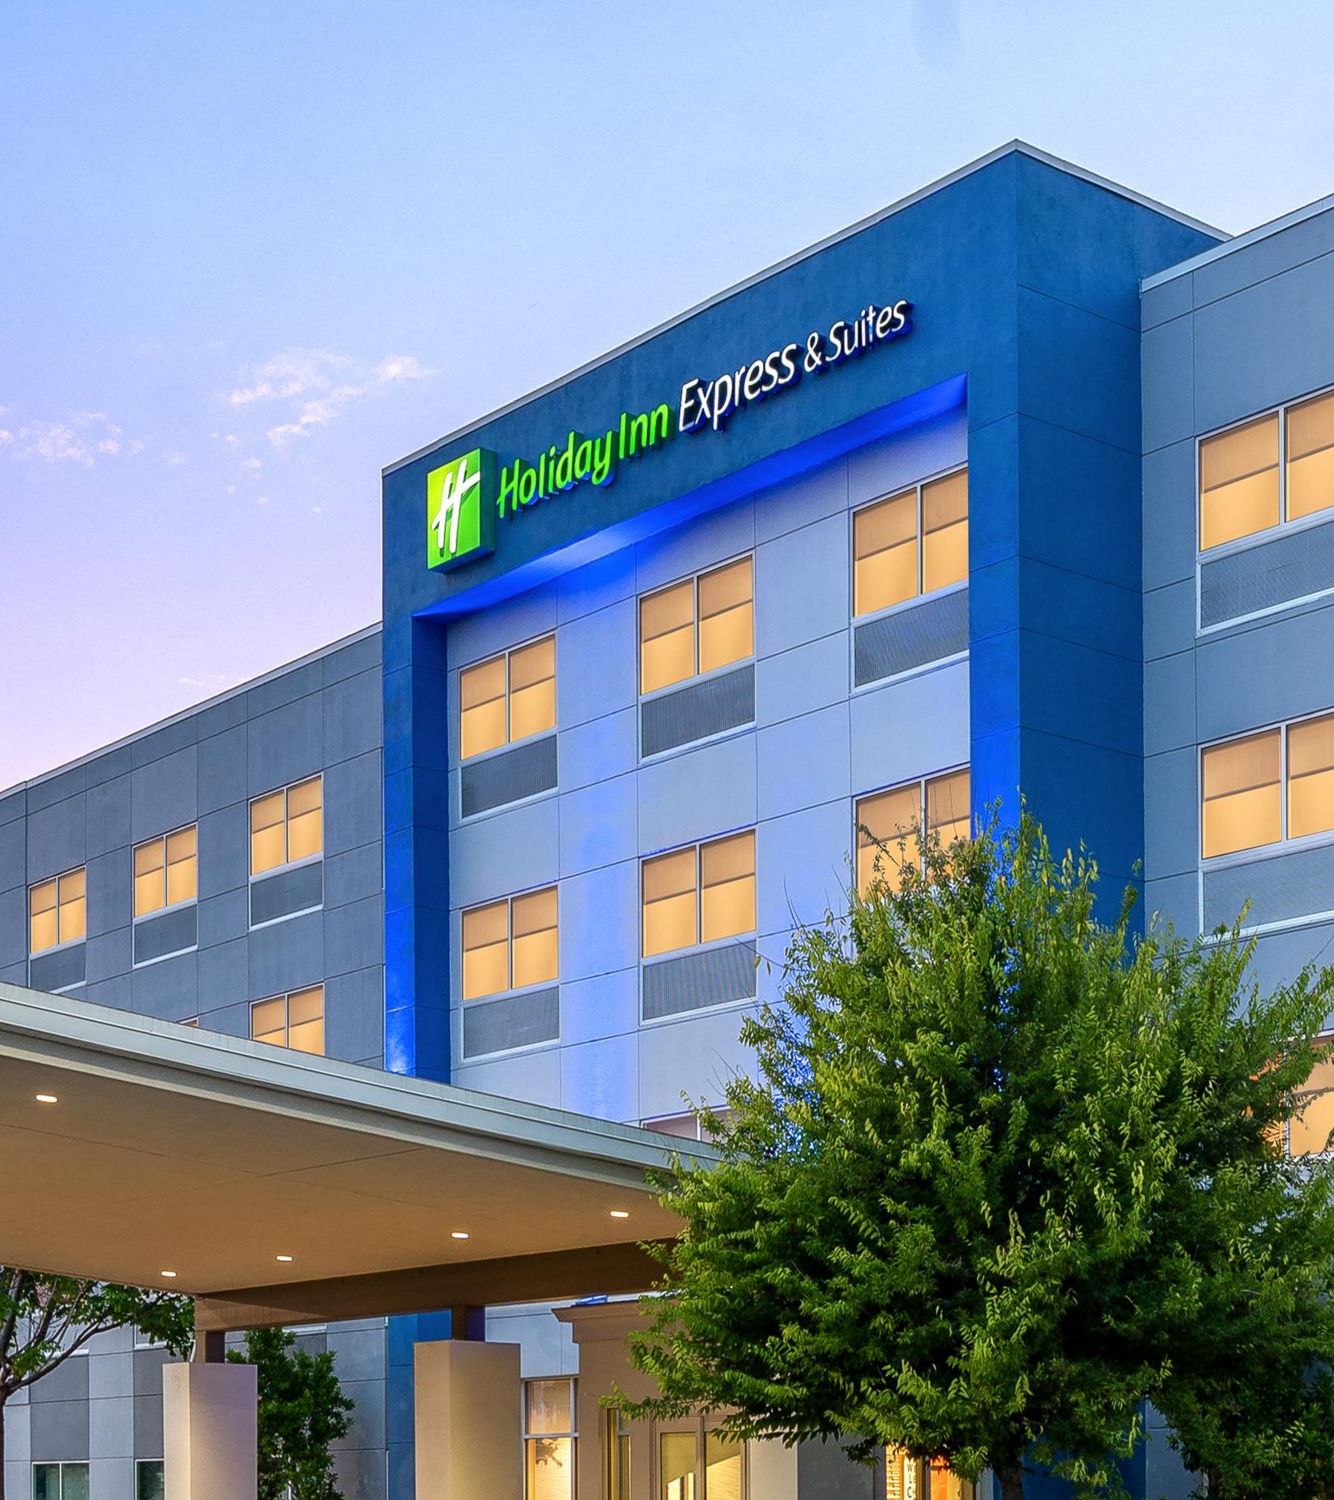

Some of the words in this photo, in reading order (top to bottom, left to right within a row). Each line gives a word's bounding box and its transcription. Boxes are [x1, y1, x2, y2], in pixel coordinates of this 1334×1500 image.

[496, 430, 612, 518] Holiday
[619, 403, 669, 459] Inn
[679, 343, 797, 432] Express
[804, 331, 822, 373] &
[825, 300, 908, 362] Suites
